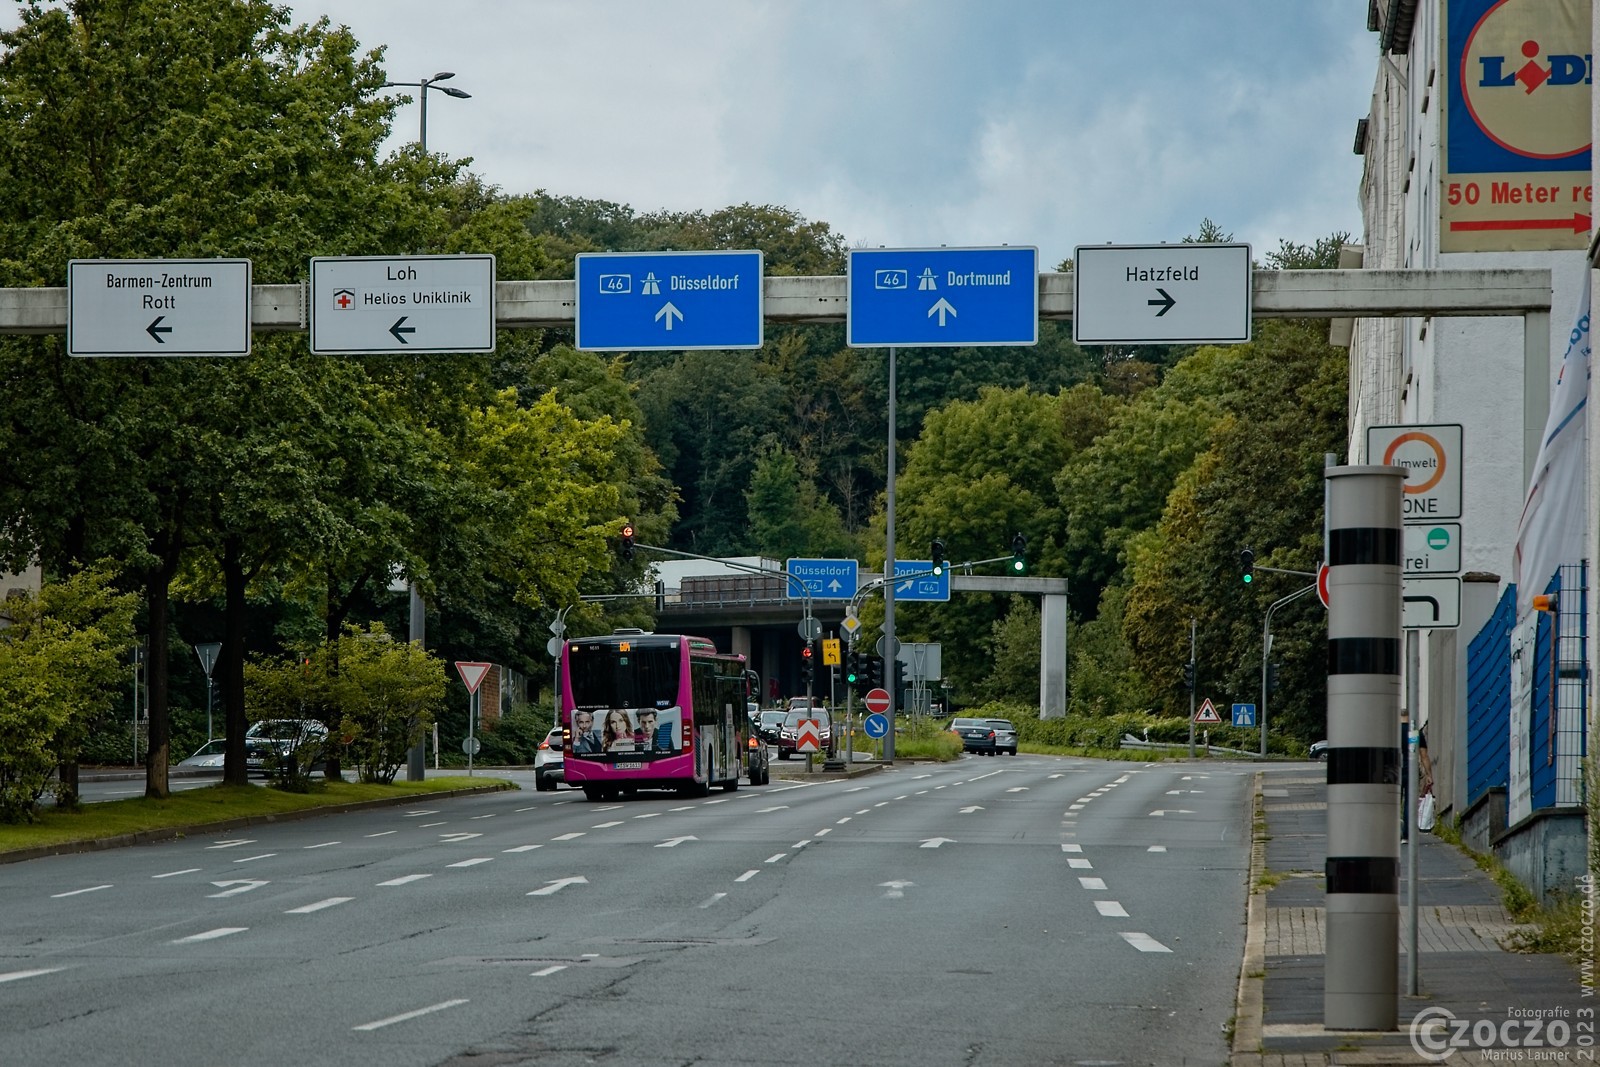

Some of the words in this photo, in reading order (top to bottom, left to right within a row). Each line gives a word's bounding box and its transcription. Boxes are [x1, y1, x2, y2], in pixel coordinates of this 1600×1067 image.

[1448, 183, 1480, 205] 50
[1491, 182, 1560, 204] Meter
[386, 266, 417, 281] Loh
[883, 272, 900, 287] 46
[947, 270, 1011, 287] Dortmund
[1126, 266, 1199, 282] Hatzfeld
[106, 273, 212, 290] Barmen-Zentrum
[607, 276, 623, 291] 46
[670, 274, 739, 291] Düsseldorf
[142, 294, 176, 310] Rott
[364, 292, 407, 306] Helios
[412, 291, 472, 305] Uniklinik
[1392, 458, 1437, 468] Umwelt
[1403, 498, 1438, 513] ONE
[1406, 554, 1429, 569] rei
[794, 565, 851, 576] Düsseldorf
[808, 580, 818, 590] 46
[924, 583, 934, 591] 46
